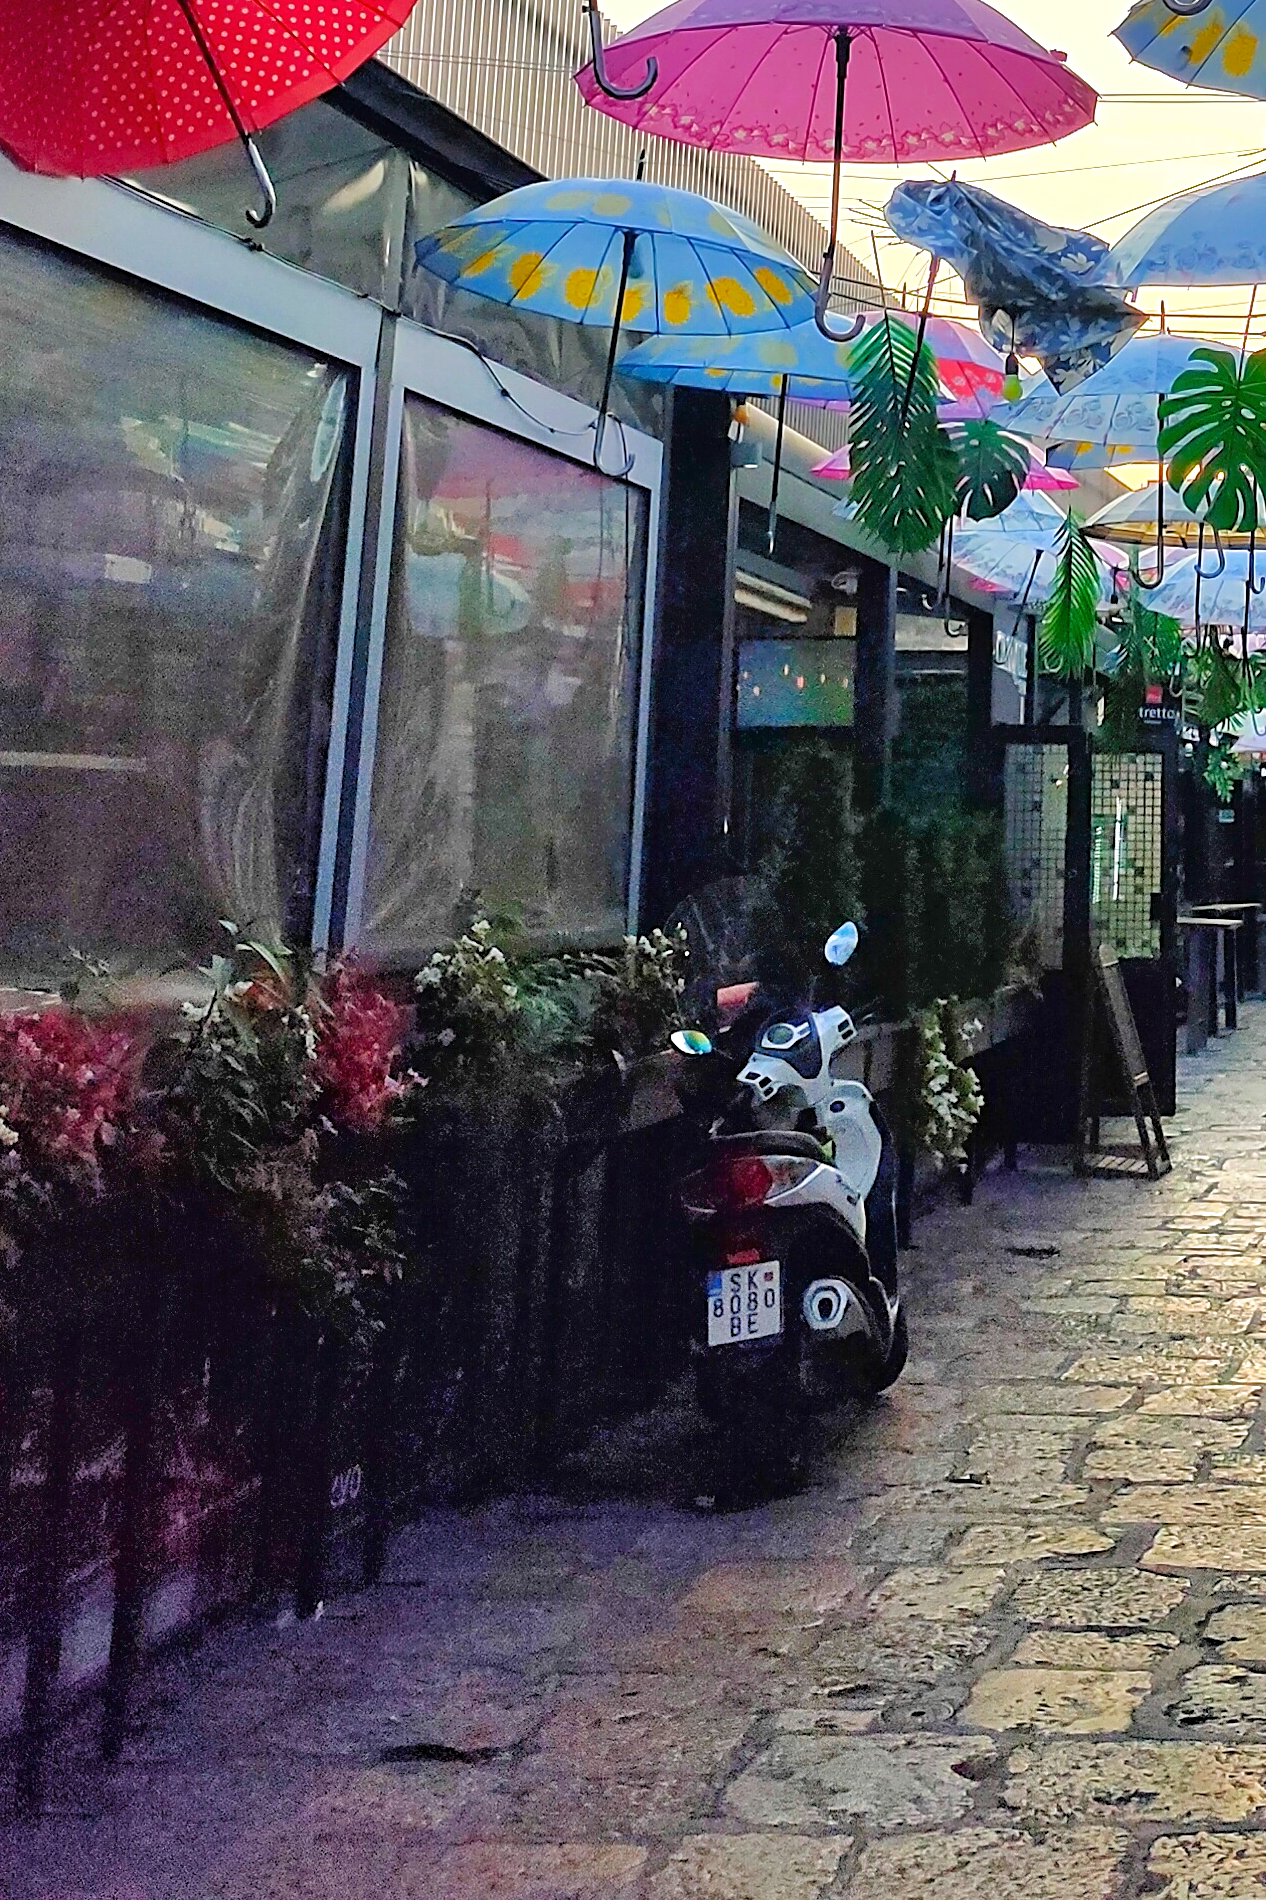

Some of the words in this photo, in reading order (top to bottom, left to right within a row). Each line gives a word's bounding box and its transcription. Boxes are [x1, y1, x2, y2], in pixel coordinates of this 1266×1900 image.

[1138, 706, 1176, 720] tretto
[730, 1270, 759, 1294] SK
[713, 1287, 776, 1318] 8080
